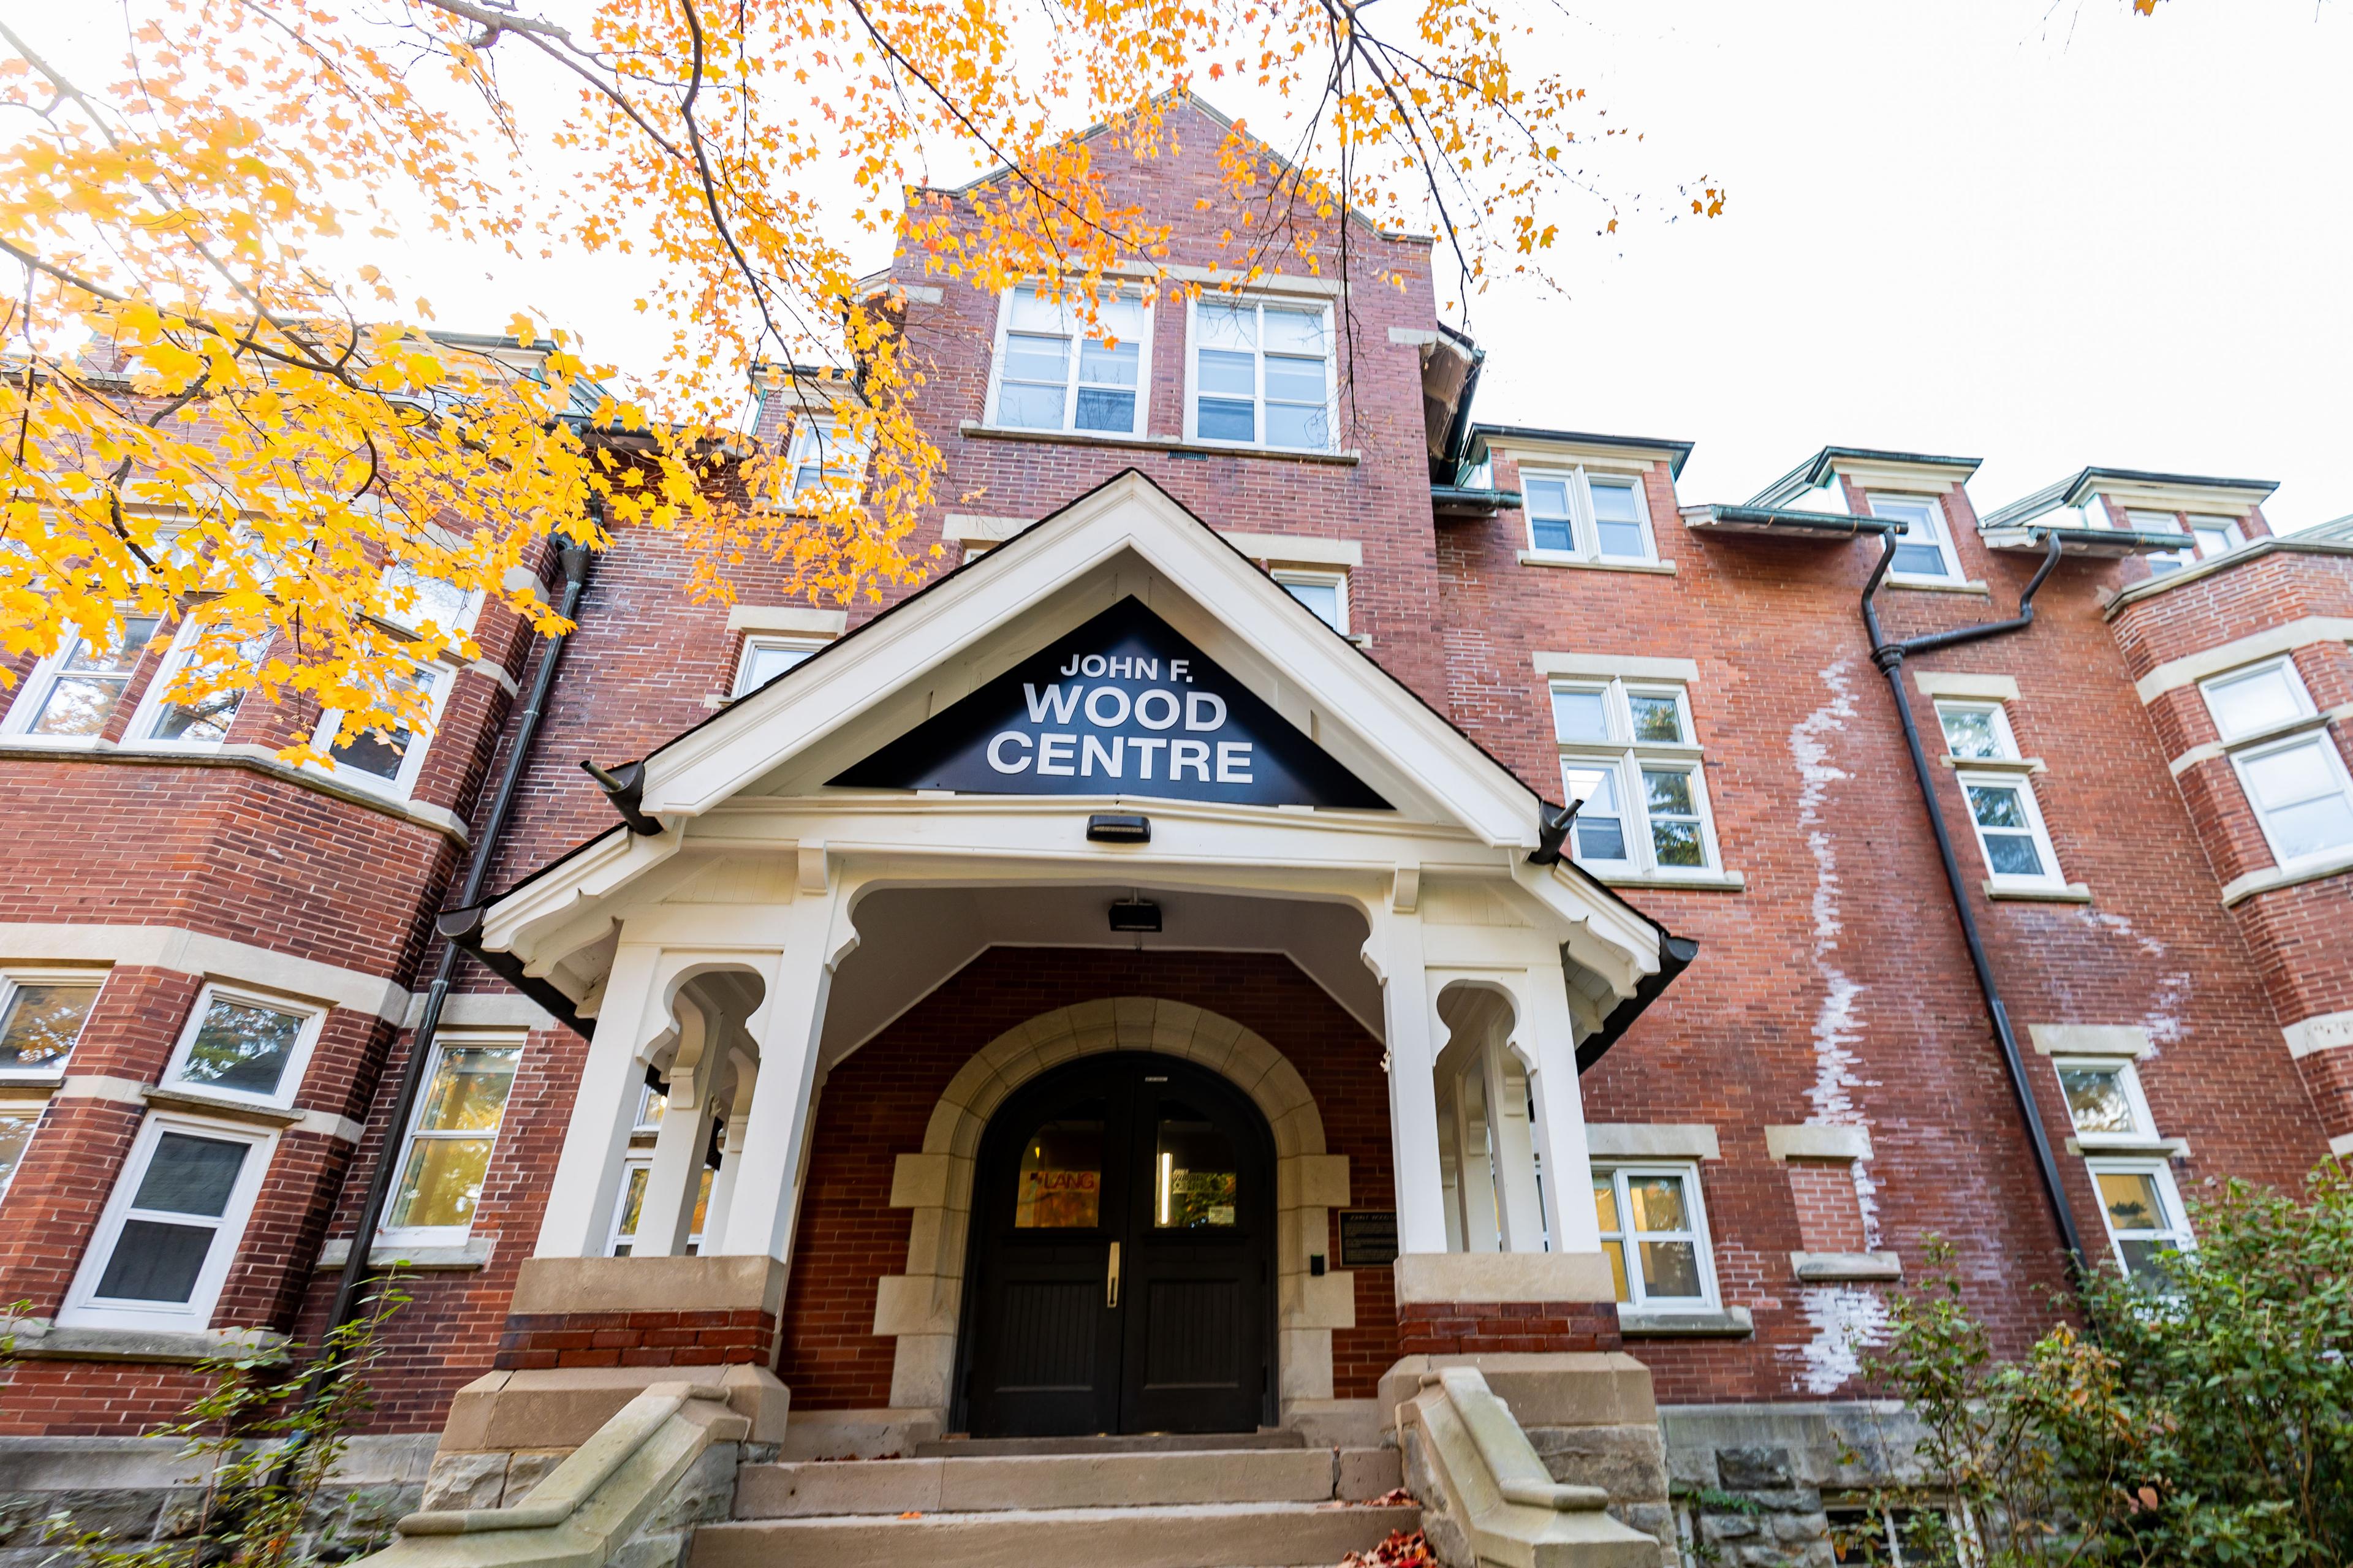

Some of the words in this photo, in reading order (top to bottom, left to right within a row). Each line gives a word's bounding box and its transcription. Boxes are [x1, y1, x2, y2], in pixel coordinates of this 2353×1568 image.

[1060, 653, 1158, 681] JOHN
[1170, 659, 1193, 683] F.
[1023, 683, 1227, 732] WOOD
[987, 730, 1253, 784] CENTRE
